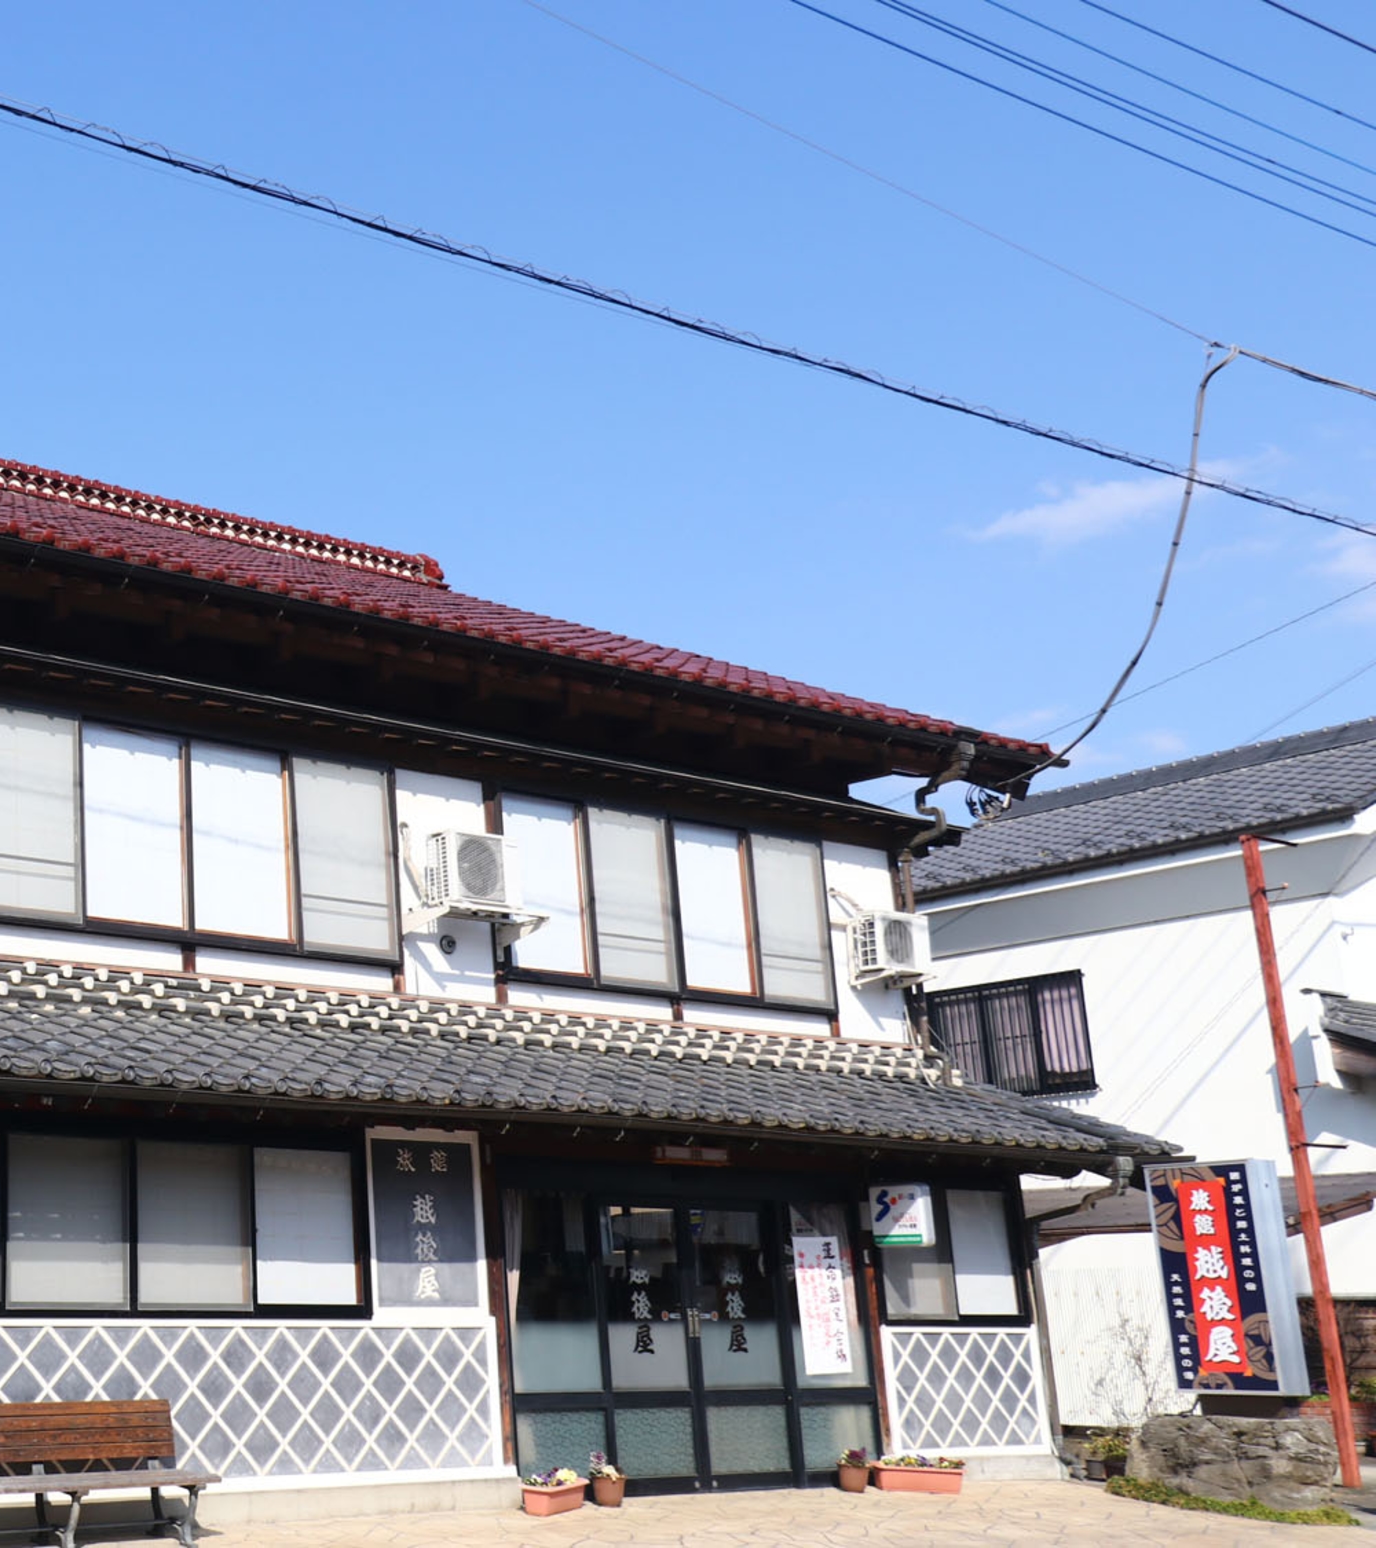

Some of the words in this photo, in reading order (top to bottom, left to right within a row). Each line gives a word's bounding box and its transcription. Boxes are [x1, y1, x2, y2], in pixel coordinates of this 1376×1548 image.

[395, 1148, 448, 1172] 旅館
[411, 1193, 441, 1300] 越後屋
[1189, 1188, 1215, 1236] 旅館
[1194, 1246, 1241, 1364] 越後屋
